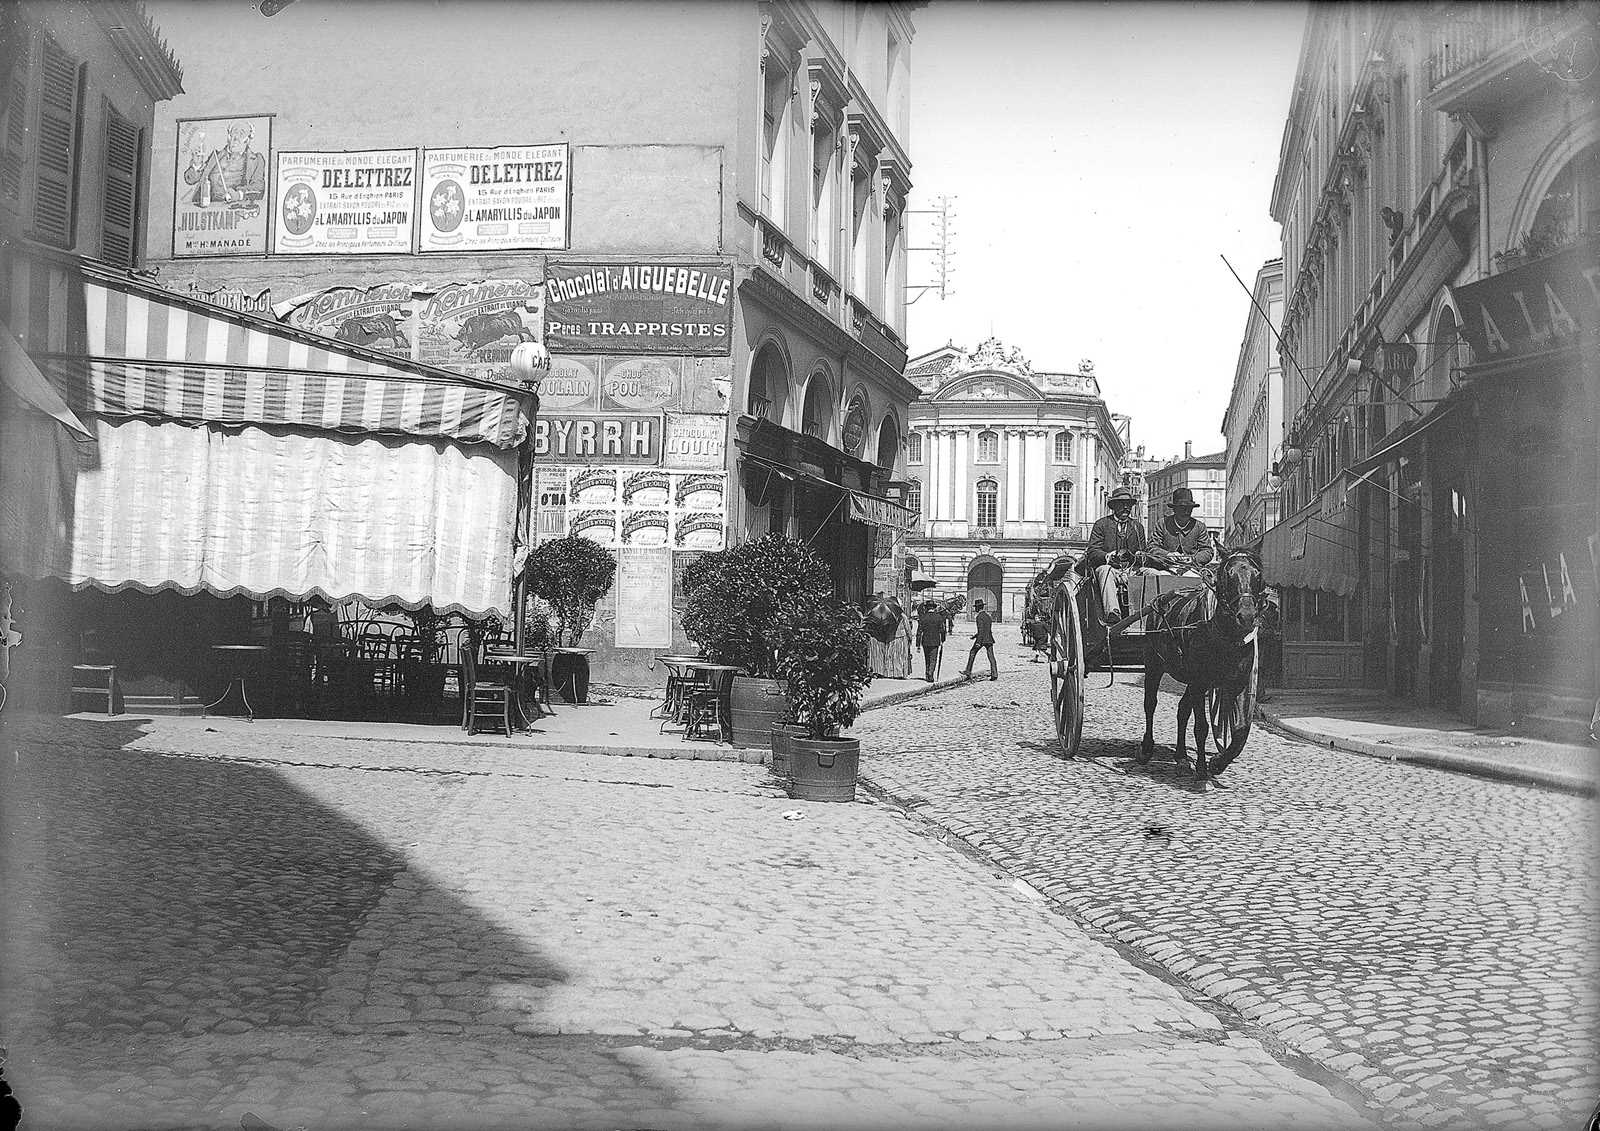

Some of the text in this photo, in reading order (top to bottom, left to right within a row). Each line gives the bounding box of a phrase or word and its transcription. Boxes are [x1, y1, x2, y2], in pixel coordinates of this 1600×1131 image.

[282, 156, 336, 166] PARFUMERIE
[345, 156, 373, 165] MONDE
[428, 152, 484, 163] PARFUMERIE
[493, 150, 522, 161] MONDE
[322, 167, 412, 189] DELETTREZ
[470, 161, 563, 185] DELETTREZ
[384, 191, 404, 199] PARIS
[534, 186, 555, 194] PARIS
[380, 210, 408, 225] JAPON
[532, 206, 561, 220] JAPON
[546, 265, 731, 306] Chocolat d'AIGUEBELLE
[297, 283, 413, 323] Kemmerich
[419, 281, 540, 323] Kemmerich
[478, 303, 500, 315] EXTRAIT
[353, 306, 375, 317] EXTRAIT
[587, 322, 726, 337] TRAPPISTES
[537, 380, 590, 397] OULAIN
[535, 419, 653, 458] BYRRH
